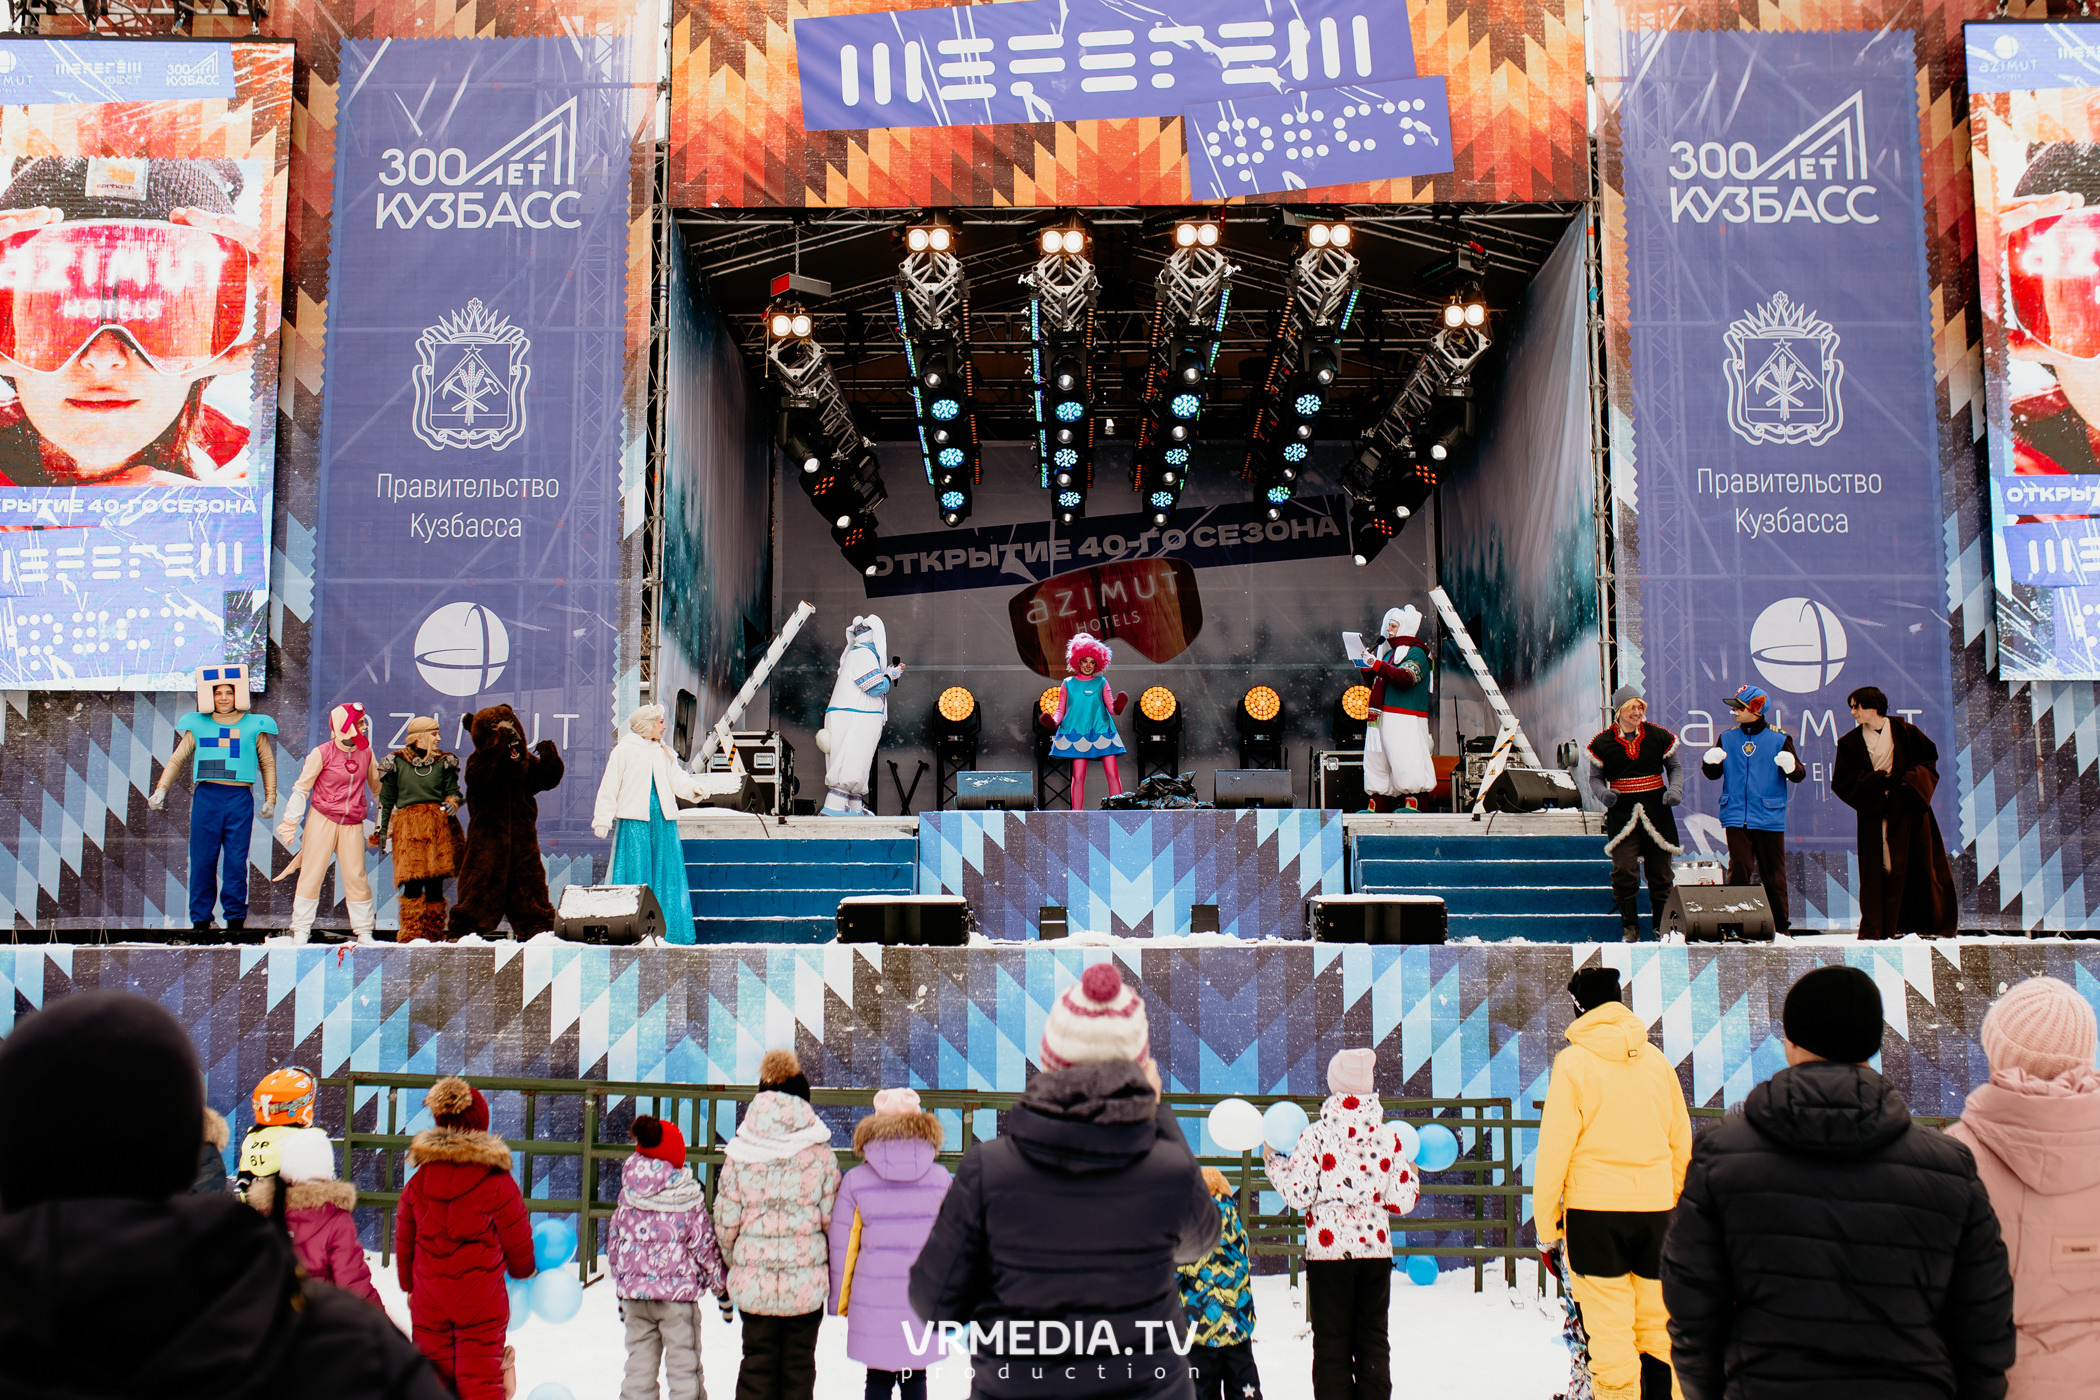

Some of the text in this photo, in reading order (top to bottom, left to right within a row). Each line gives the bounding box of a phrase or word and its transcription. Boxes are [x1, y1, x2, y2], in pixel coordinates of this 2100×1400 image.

[166, 75, 220, 87] КУЗБАСС
[167, 64, 190, 75] 300
[378, 148, 468, 186] 300
[1668, 141, 1760, 180] 300
[376, 190, 582, 230] КУЗБАСС
[1669, 185, 1880, 224] КУЗБАСС
[63, 299, 162, 319] HOTELS
[377, 473, 559, 503] Правительство
[1697, 468, 1882, 499] Правительство
[162, 499, 257, 514] СЕЗОНА
[410, 512, 522, 543] Кузбасса
[1735, 506, 1848, 539] Кузбасса
[875, 539, 1072, 577] ОТКРЫТИЕ
[1193, 516, 1341, 548] СЕЗОНА
[1076, 611, 1141, 633] HOTELS
